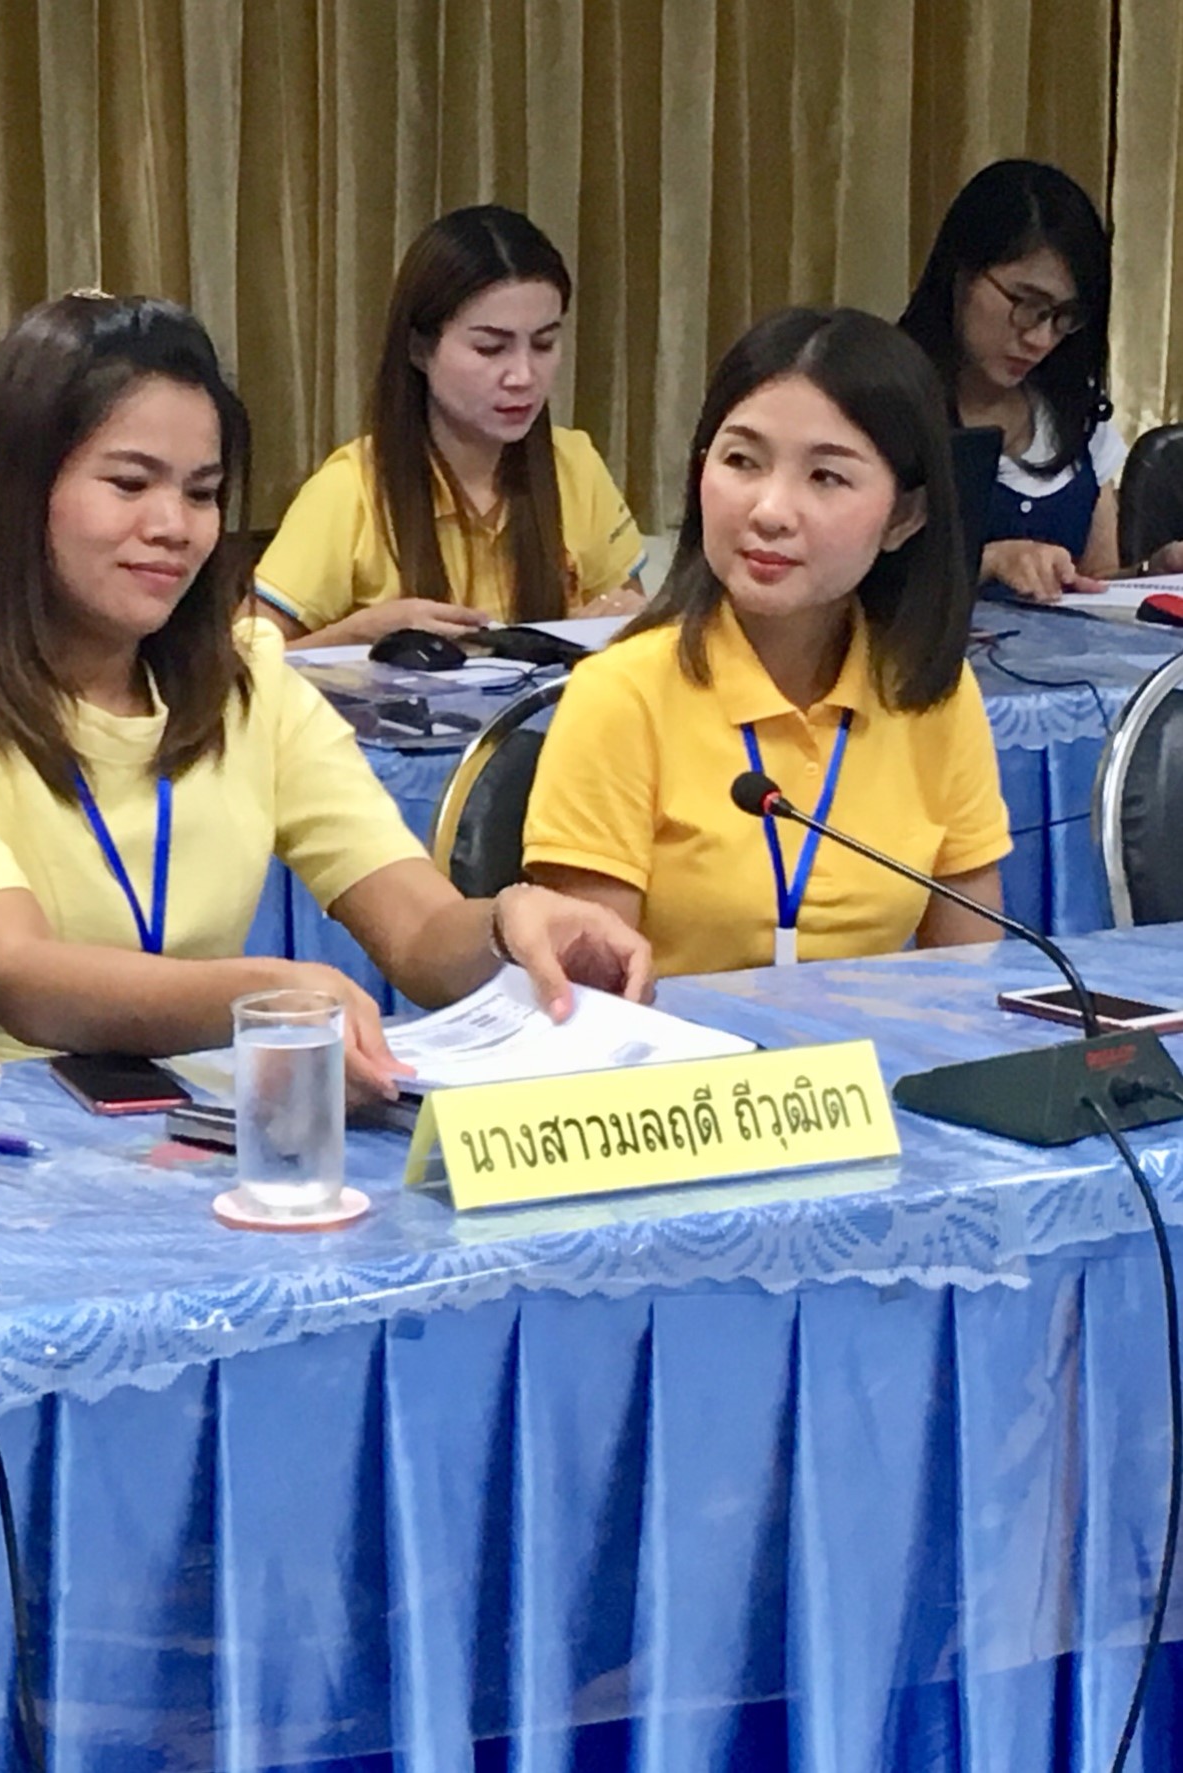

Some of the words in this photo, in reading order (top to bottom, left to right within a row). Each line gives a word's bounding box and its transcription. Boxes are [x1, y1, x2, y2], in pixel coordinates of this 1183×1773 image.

[460, 1084, 723, 1174] นางสาวมลฤดี
